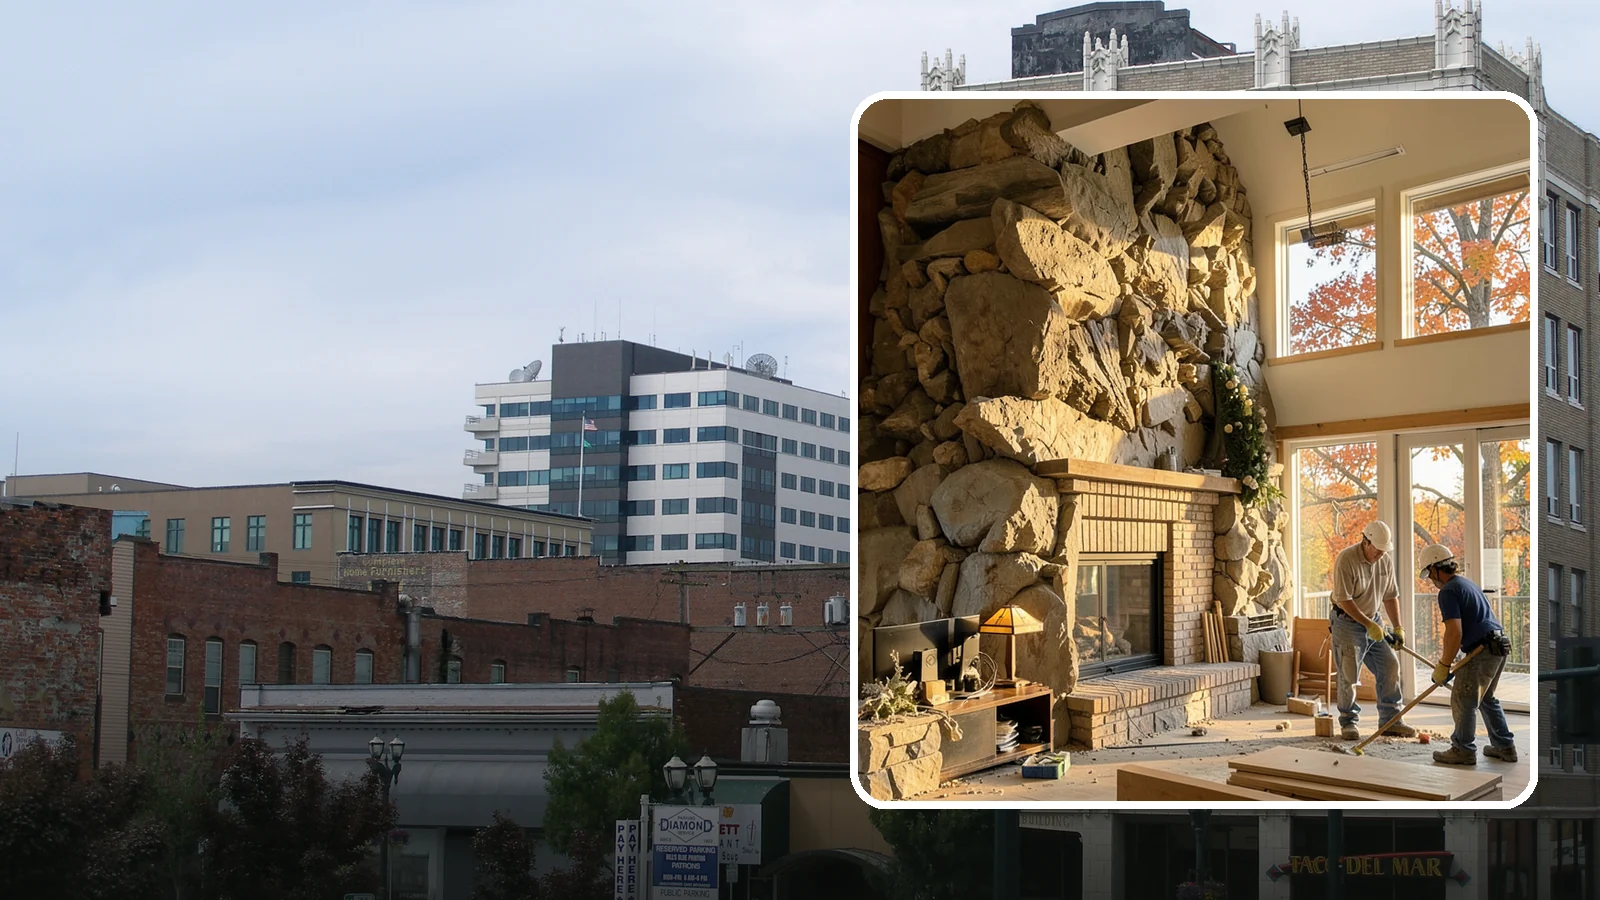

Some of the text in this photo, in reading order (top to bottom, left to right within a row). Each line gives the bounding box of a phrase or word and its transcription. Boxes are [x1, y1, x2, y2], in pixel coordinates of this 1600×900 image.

[370, 566, 427, 576] Furnishers
[660, 818, 713, 832] DIAMOND
[1022, 814, 1070, 828] BUILDING
[616, 825, 625, 893] PAY HERE
[628, 824, 636, 893] PAY HERE
[722, 852, 739, 862] Soup
[1288, 855, 1442, 877] TAC DEL MAR
[660, 888, 710, 898] PUBLIC PARKING
